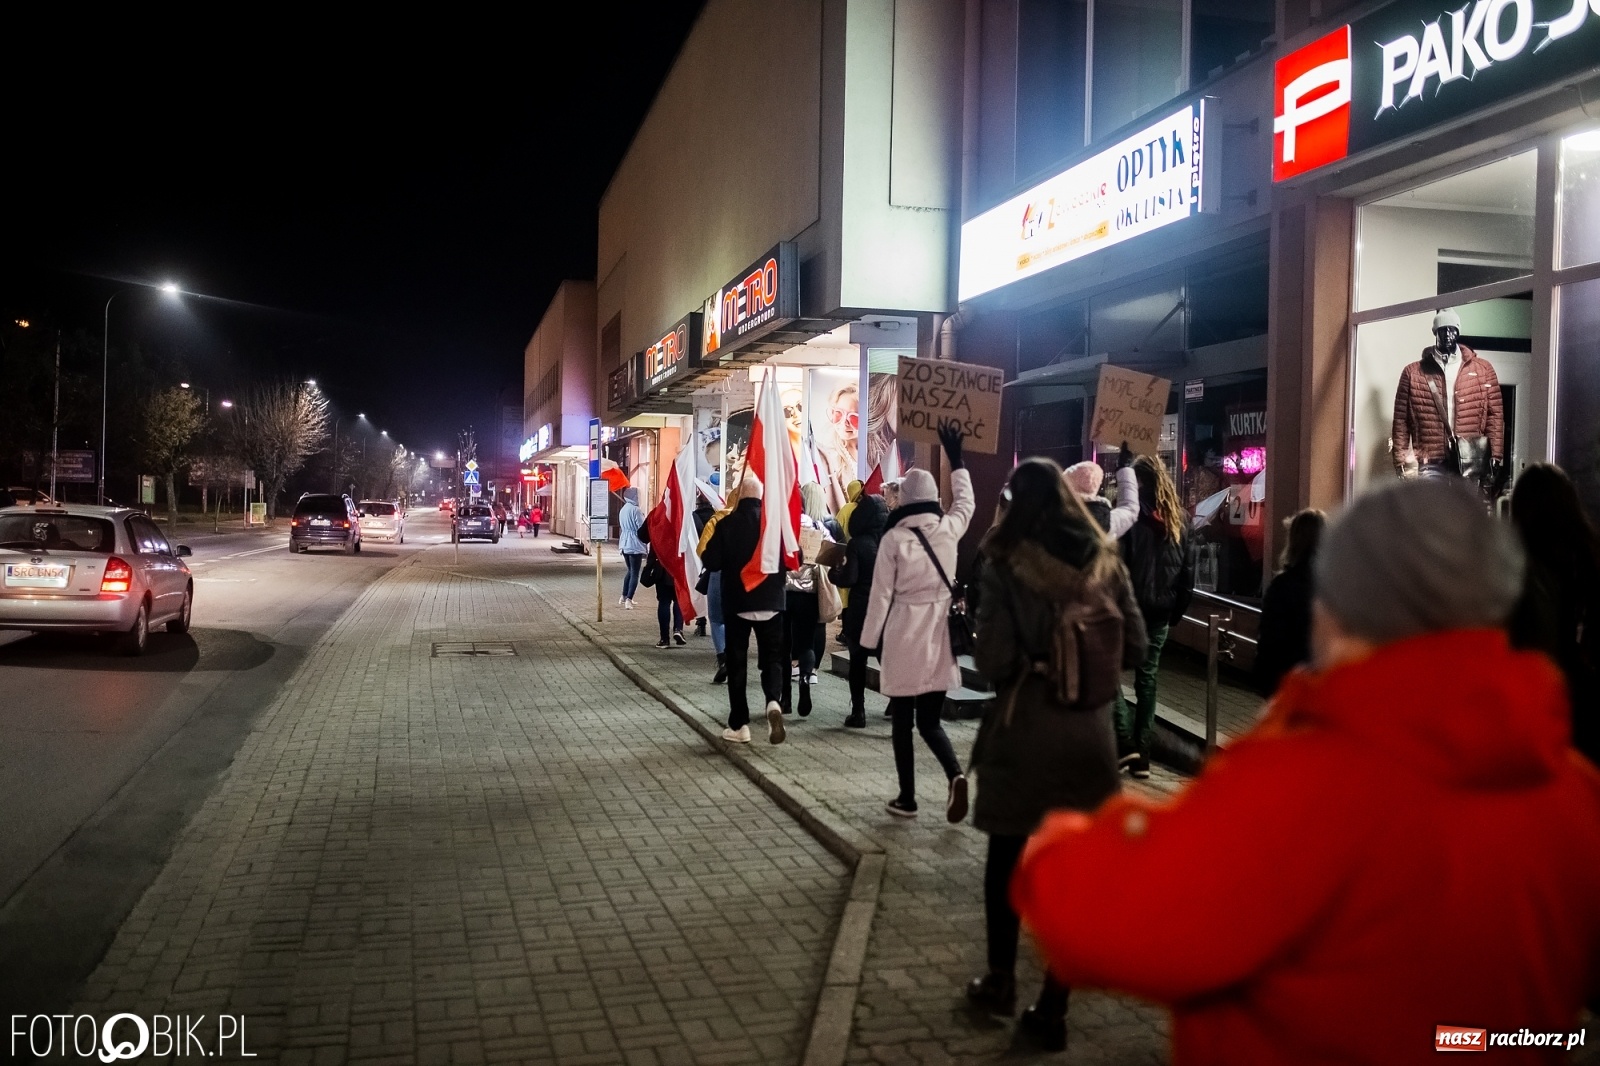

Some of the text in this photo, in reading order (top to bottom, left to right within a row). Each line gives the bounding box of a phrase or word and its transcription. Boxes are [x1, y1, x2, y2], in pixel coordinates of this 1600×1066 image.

[1380, 0, 1534, 110] PAKO
[1117, 129, 1185, 193] OPTYK
[722, 258, 778, 334] METRO
[738, 307, 775, 335] UNDERGROUND
[645, 323, 687, 380] METRO
[902, 361, 1002, 394] ZOSTAWCIE
[14, 567, 34, 577] SRC
